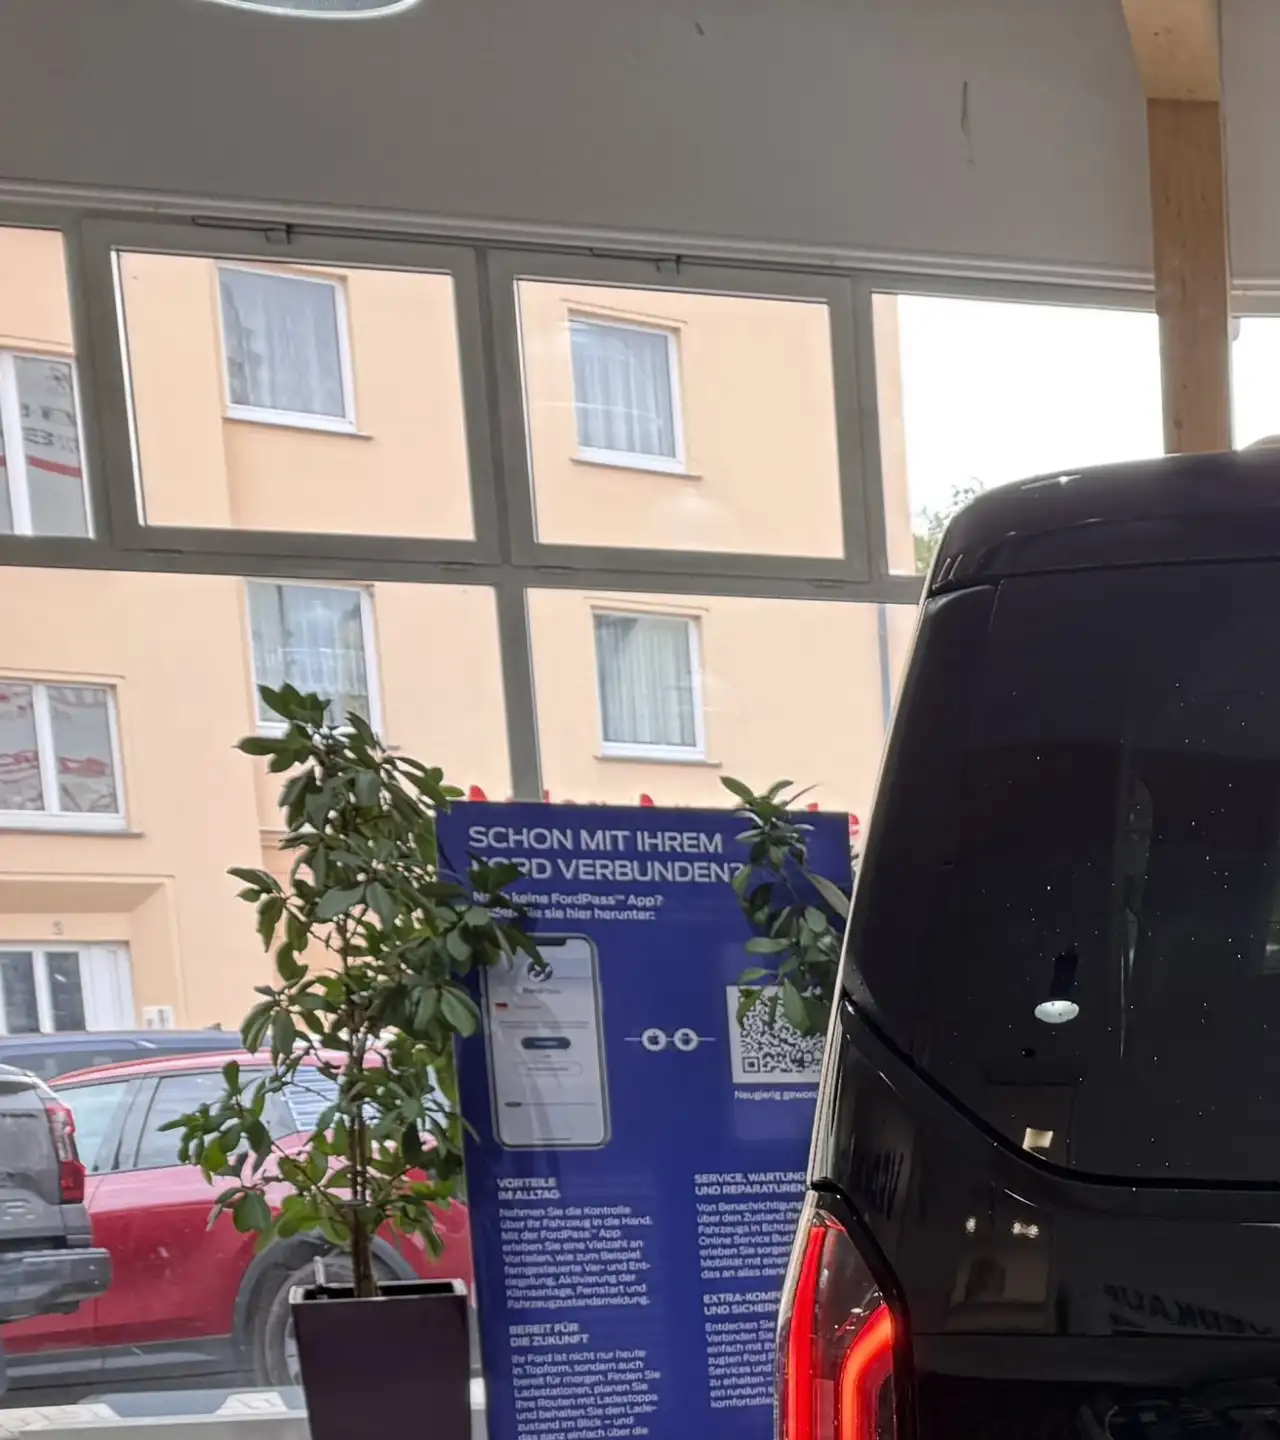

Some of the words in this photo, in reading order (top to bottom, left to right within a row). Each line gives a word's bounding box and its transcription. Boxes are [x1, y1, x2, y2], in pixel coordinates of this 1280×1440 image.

[468, 826, 573, 850] SCHON
[580, 830, 630, 851] MIT
[636, 832, 722, 854] IHREM
[512, 892, 548, 904] keine
[627, 895, 663, 906] App?
[544, 907, 564, 918] sie
[566, 908, 593, 919] hier
[595, 908, 656, 920] herunter:
[497, 1177, 557, 1188] VORTEILE
[694, 1173, 746, 1183] SERVICE,
[515, 1190, 561, 1199] ALLTAG
[695, 1185, 720, 1195] UND
[547, 1207, 563, 1216] Sie
[565, 1206, 581, 1216] die
[584, 1205, 631, 1215] Kontrolle
[696, 1202, 716, 1212] Von
[543, 1217, 591, 1228] Fahrzeug
[593, 1217, 601, 1225] in
[604, 1217, 619, 1225] die
[622, 1216, 652, 1225] Hand.
[697, 1213, 720, 1223] über
[722, 1213, 741, 1222] den
[744, 1211, 783, 1221] Zustand
[751, 1224, 760, 1232] in
[521, 1231, 538, 1240] der
[599, 1229, 620, 1239] App
[699, 1236, 732, 1245] Online
[734, 1234, 771, 1244] Service
[545, 1241, 561, 1250] Sie
[587, 1240, 627, 1249] Vielzahl
[630, 1240, 643, 1248] an
[555, 1253, 574, 1262] wie
[576, 1253, 598, 1261] zum
[601, 1250, 641, 1261] Beispiel
[700, 1247, 737, 1256] erleben
[740, 1246, 755, 1255] Sie
[745, 1257, 760, 1265] mit
[584, 1264, 604, 1272] Ver-
[607, 1262, 627, 1270] und
[629, 1262, 651, 1270] Ent-
[558, 1274, 616, 1284] Aktivierung
[701, 1270, 719, 1279] das
[737, 1268, 760, 1277] alles
[576, 1285, 623, 1295] Fernstart
[627, 1284, 646, 1292] und
[704, 1305, 729, 1315] UND
[509, 1324, 552, 1335] BEREIT
[554, 1322, 578, 1333] FÜR
[510, 1337, 529, 1347] DIE
[532, 1334, 589, 1346] ZUKUNFT
[707, 1344, 743, 1353] einfach
[745, 1342, 762, 1351] mit
[528, 1352, 552, 1363] Ford
[554, 1352, 566, 1361] ist
[569, 1351, 595, 1361] nicht
[616, 1349, 646, 1358] heute
[743, 1354, 766, 1362] Ford
[513, 1366, 522, 1375] in
[574, 1362, 616, 1372] sondern
[618, 1360, 643, 1369] auch
[708, 1366, 751, 1375] Services
[752, 1364, 771, 1372] und
[546, 1375, 560, 1384] für
[608, 1371, 642, 1381] Finden
[645, 1370, 660, 1378] Sie
[594, 1383, 629, 1394] planen
[632, 1382, 648, 1391] Sie
[709, 1379, 721, 1387] zu
[710, 1389, 725, 1397] ein
[727, 1386, 765, 1395] rundum
[538, 1398, 575, 1407] Routen
[577, 1397, 595, 1405] mit
[597, 1393, 658, 1404] Ladestopps
[516, 1411, 536, 1420] und
[539, 1407, 584, 1418] behalten
[586, 1407, 603, 1416] Sie
[606, 1405, 625, 1414] den
[627, 1403, 657, 1413] Lade-
[518, 1421, 559, 1431] zustand
[562, 1420, 575, 1428] im
[577, 1417, 601, 1428] Blick
[614, 1416, 634, 1425] und
[567, 1428, 605, 1439] einfach
[607, 1426, 630, 1436] über
[632, 1426, 648, 1435] die
